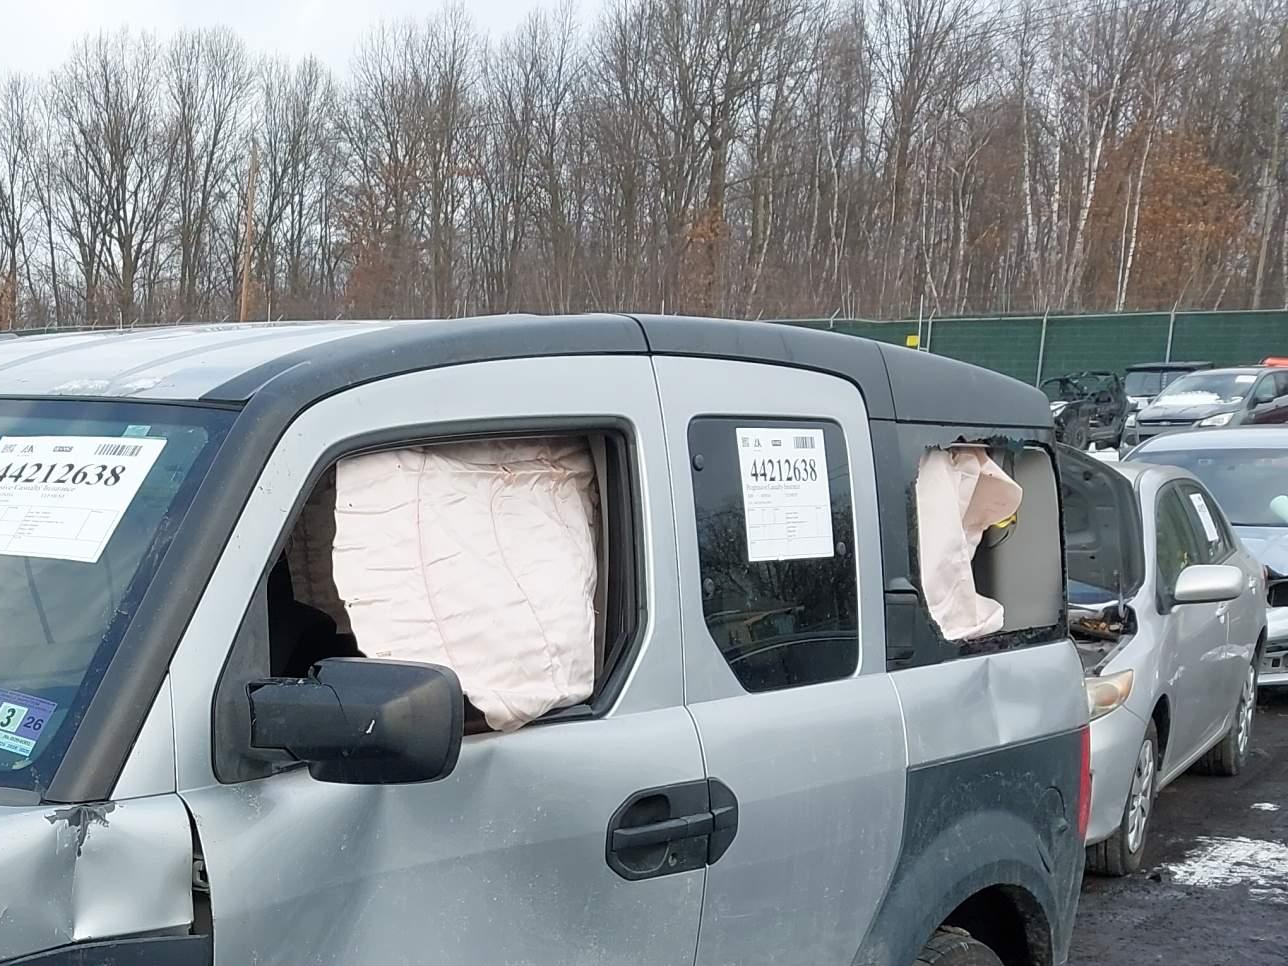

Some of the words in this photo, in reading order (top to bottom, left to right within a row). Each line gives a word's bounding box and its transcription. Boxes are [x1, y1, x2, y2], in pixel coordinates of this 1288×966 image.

[750, 458, 818, 482] 44212638
[0, 708, 16, 728] 3
[24, 716, 44, 731] 26
